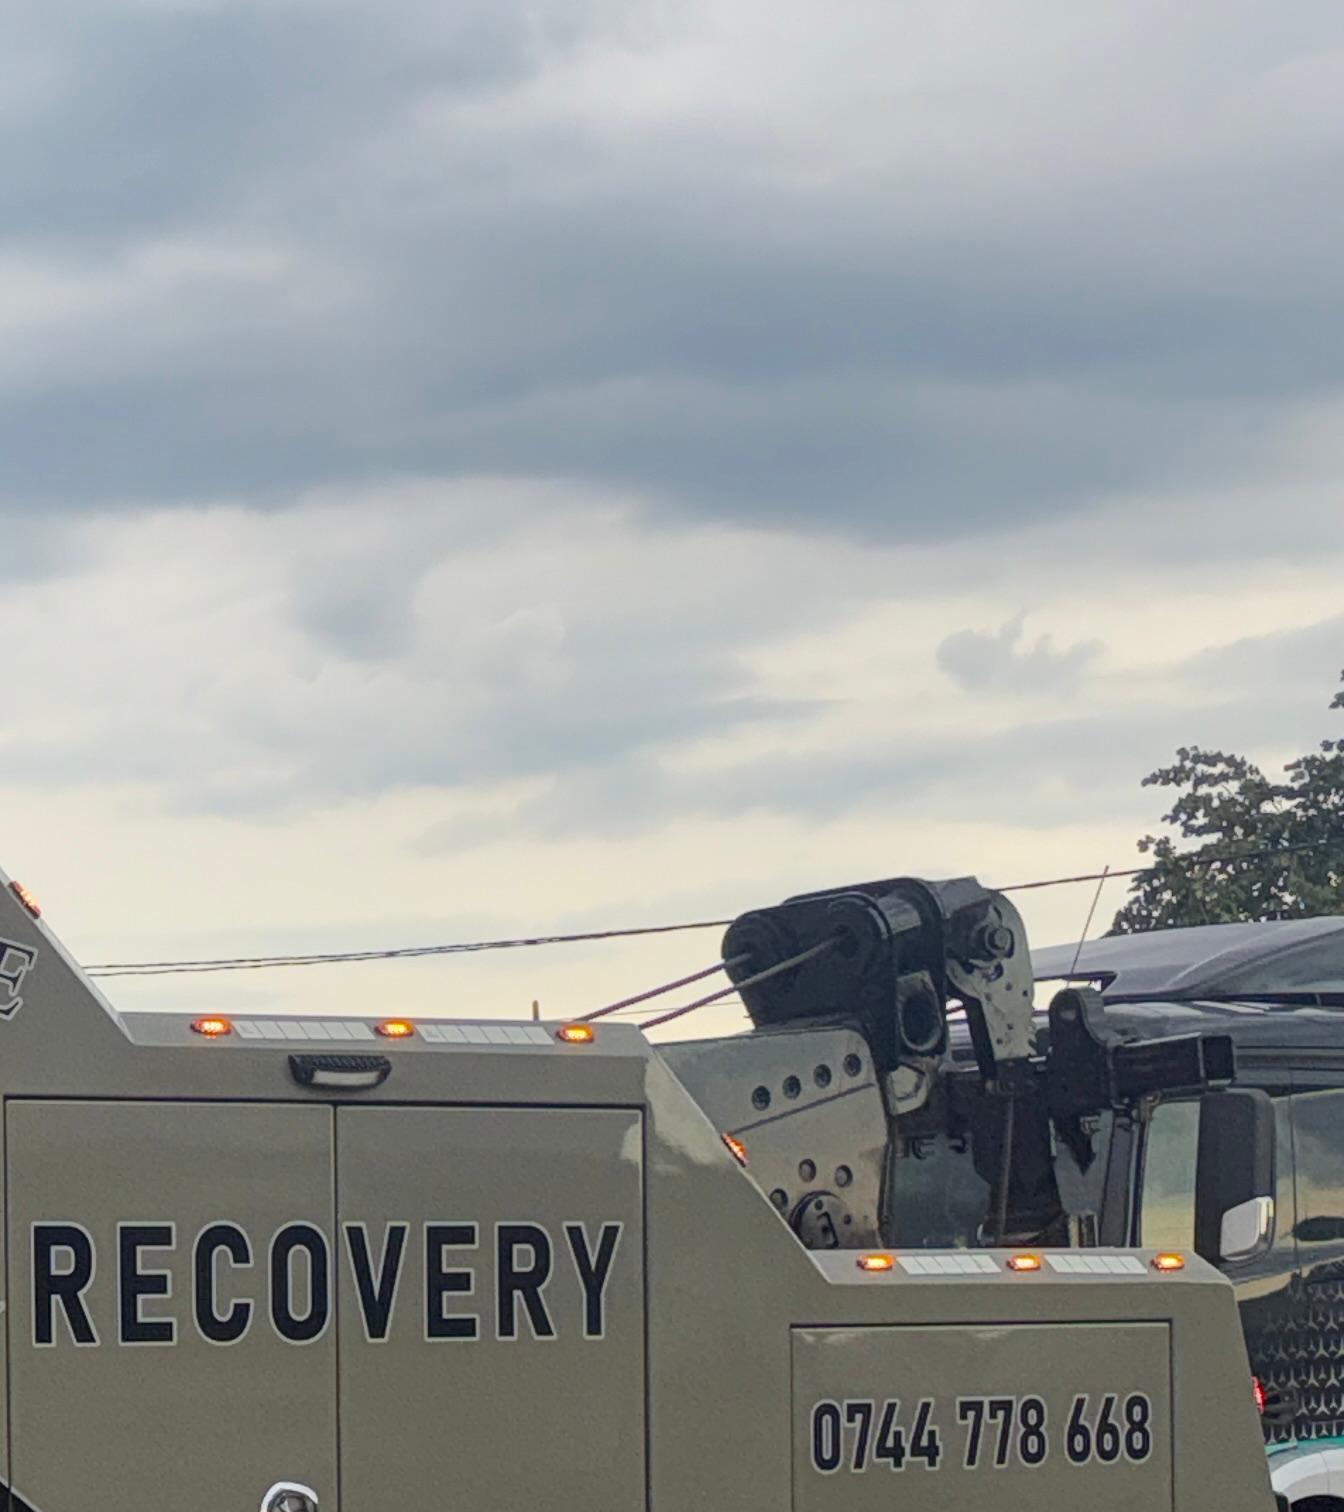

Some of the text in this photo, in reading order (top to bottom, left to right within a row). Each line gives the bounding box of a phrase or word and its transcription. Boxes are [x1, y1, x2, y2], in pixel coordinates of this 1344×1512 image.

[30, 1221, 623, 1346] RECOVERY
[812, 1393, 1150, 1475] 0744 778 668
